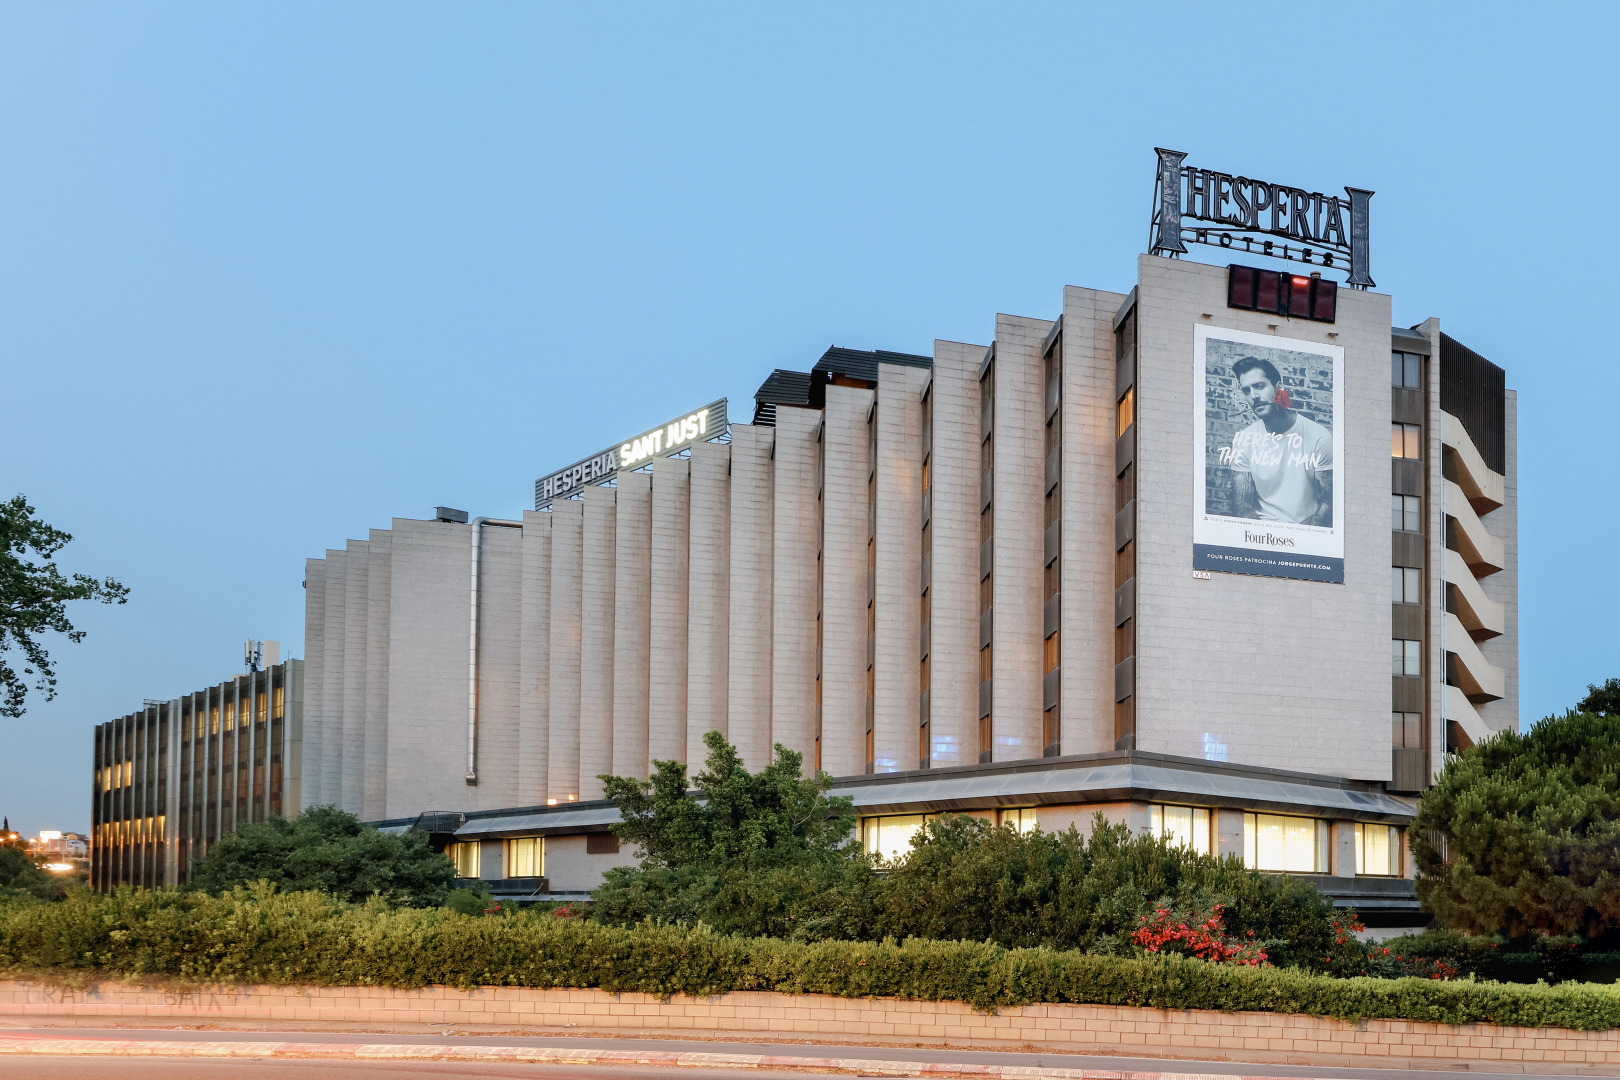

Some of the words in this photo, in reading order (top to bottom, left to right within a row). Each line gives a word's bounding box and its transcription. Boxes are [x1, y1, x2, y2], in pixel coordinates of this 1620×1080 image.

[1196, 229, 1334, 267] HOTELES
[1231, 431, 1284, 451] HERE'S
[1286, 432, 1303, 451] TO
[542, 450, 618, 500] HESPERIA
[619, 428, 664, 467] SANT
[666, 409, 709, 449] JUST
[1217, 446, 1245, 467] THE
[1250, 449, 1283, 466] NEW
[1286, 452, 1322, 471] MAN
[1244, 557, 1277, 566] PATROCINA
